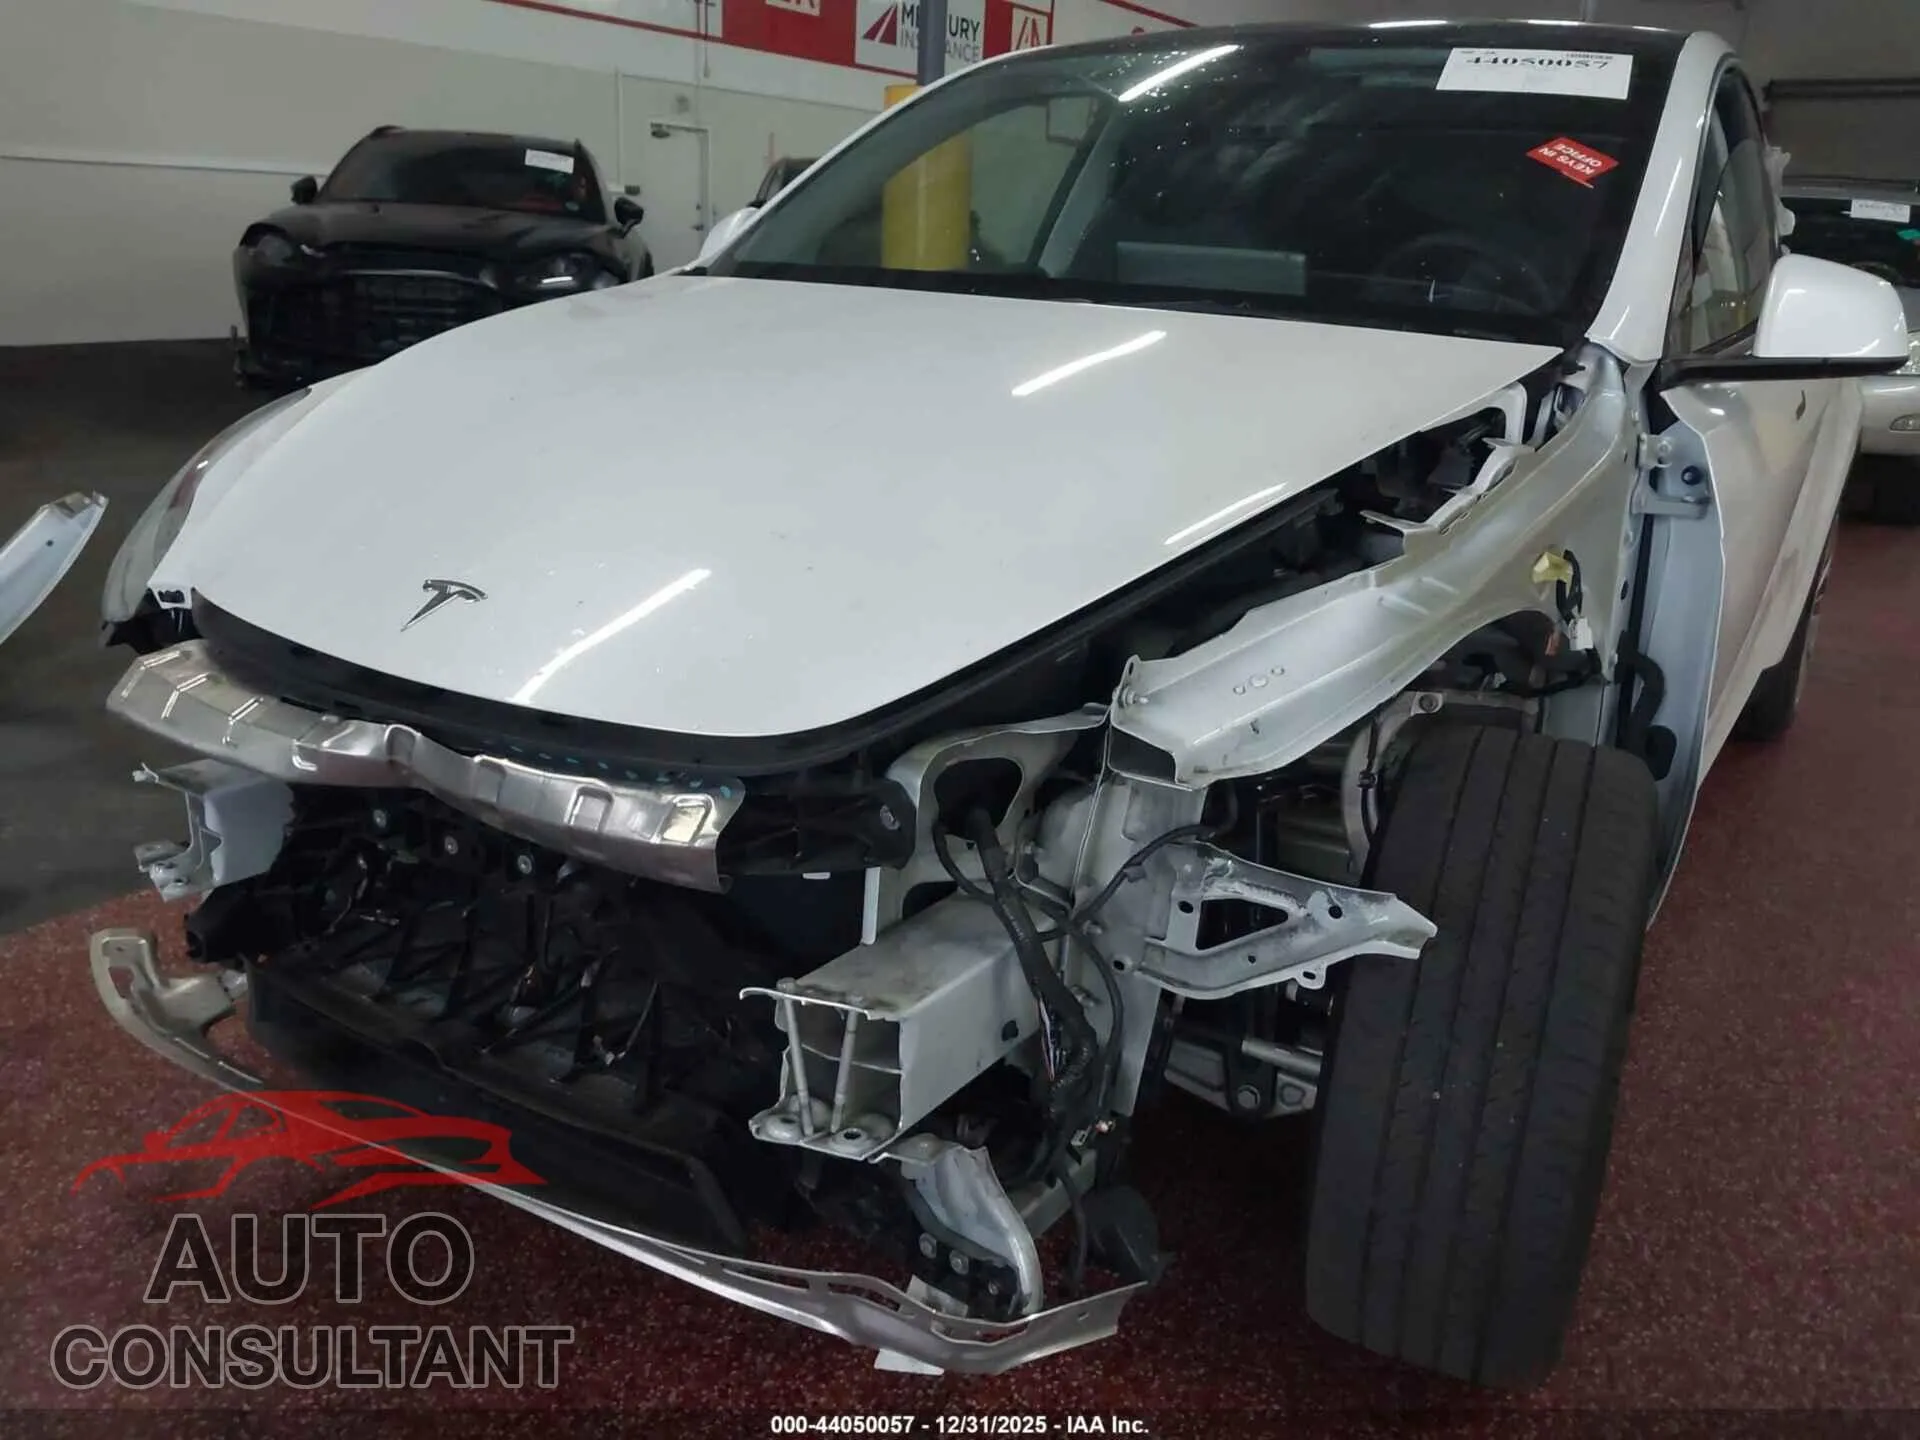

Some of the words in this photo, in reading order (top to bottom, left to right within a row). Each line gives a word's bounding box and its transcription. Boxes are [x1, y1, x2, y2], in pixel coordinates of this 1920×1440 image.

[901, 3, 981, 42] MURY
[1538, 147, 1557, 157] IN
[1552, 143, 1603, 167] OFFICE
[1556, 155, 1596, 175] KEYS
